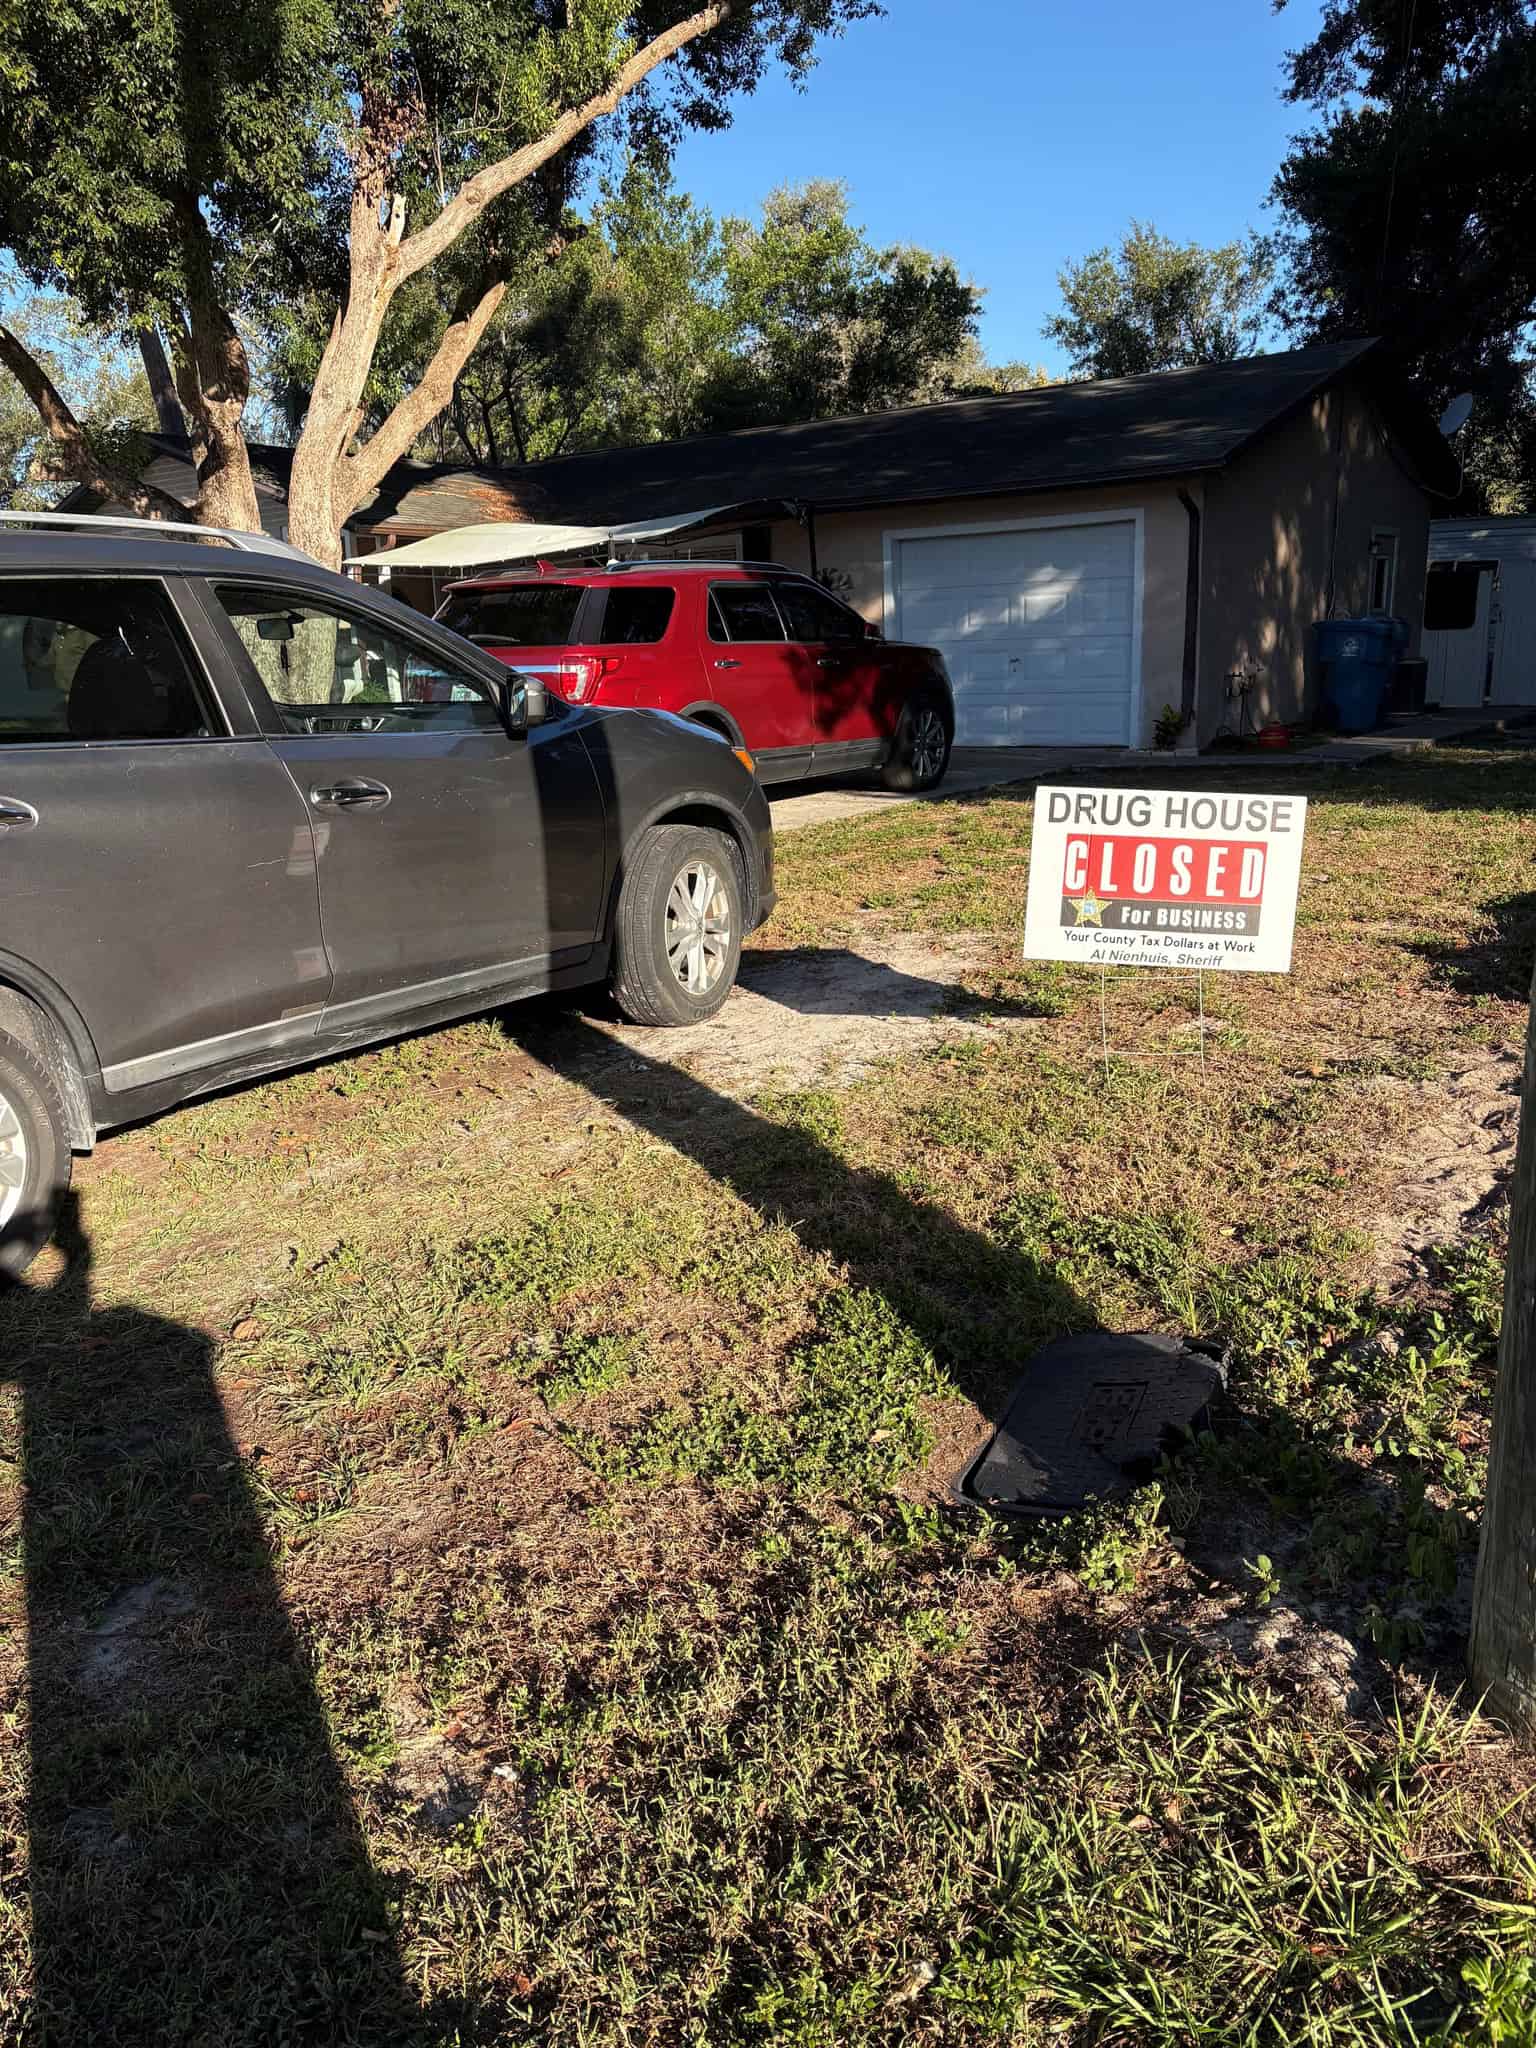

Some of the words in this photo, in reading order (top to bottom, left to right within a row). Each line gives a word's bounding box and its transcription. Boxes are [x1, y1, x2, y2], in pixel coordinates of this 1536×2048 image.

[1048, 792, 1151, 827] DRUG
[1164, 796, 1293, 833] HOUSE
[1065, 839, 1265, 899] CLOSED
[1121, 906, 1151, 925] For
[1156, 908, 1247, 930] BUSINESS
[1064, 929, 1090, 943] Your
[1093, 932, 1136, 948] County
[1140, 934, 1161, 947] Tax
[1163, 935, 1205, 950] Dollars
[1207, 941, 1220, 951] at
[1223, 940, 1256, 953] Work
[1090, 948, 1106, 960] Al
[1108, 949, 1172, 966] Nienhuis,
[1176, 953, 1225, 967] Sheriff
